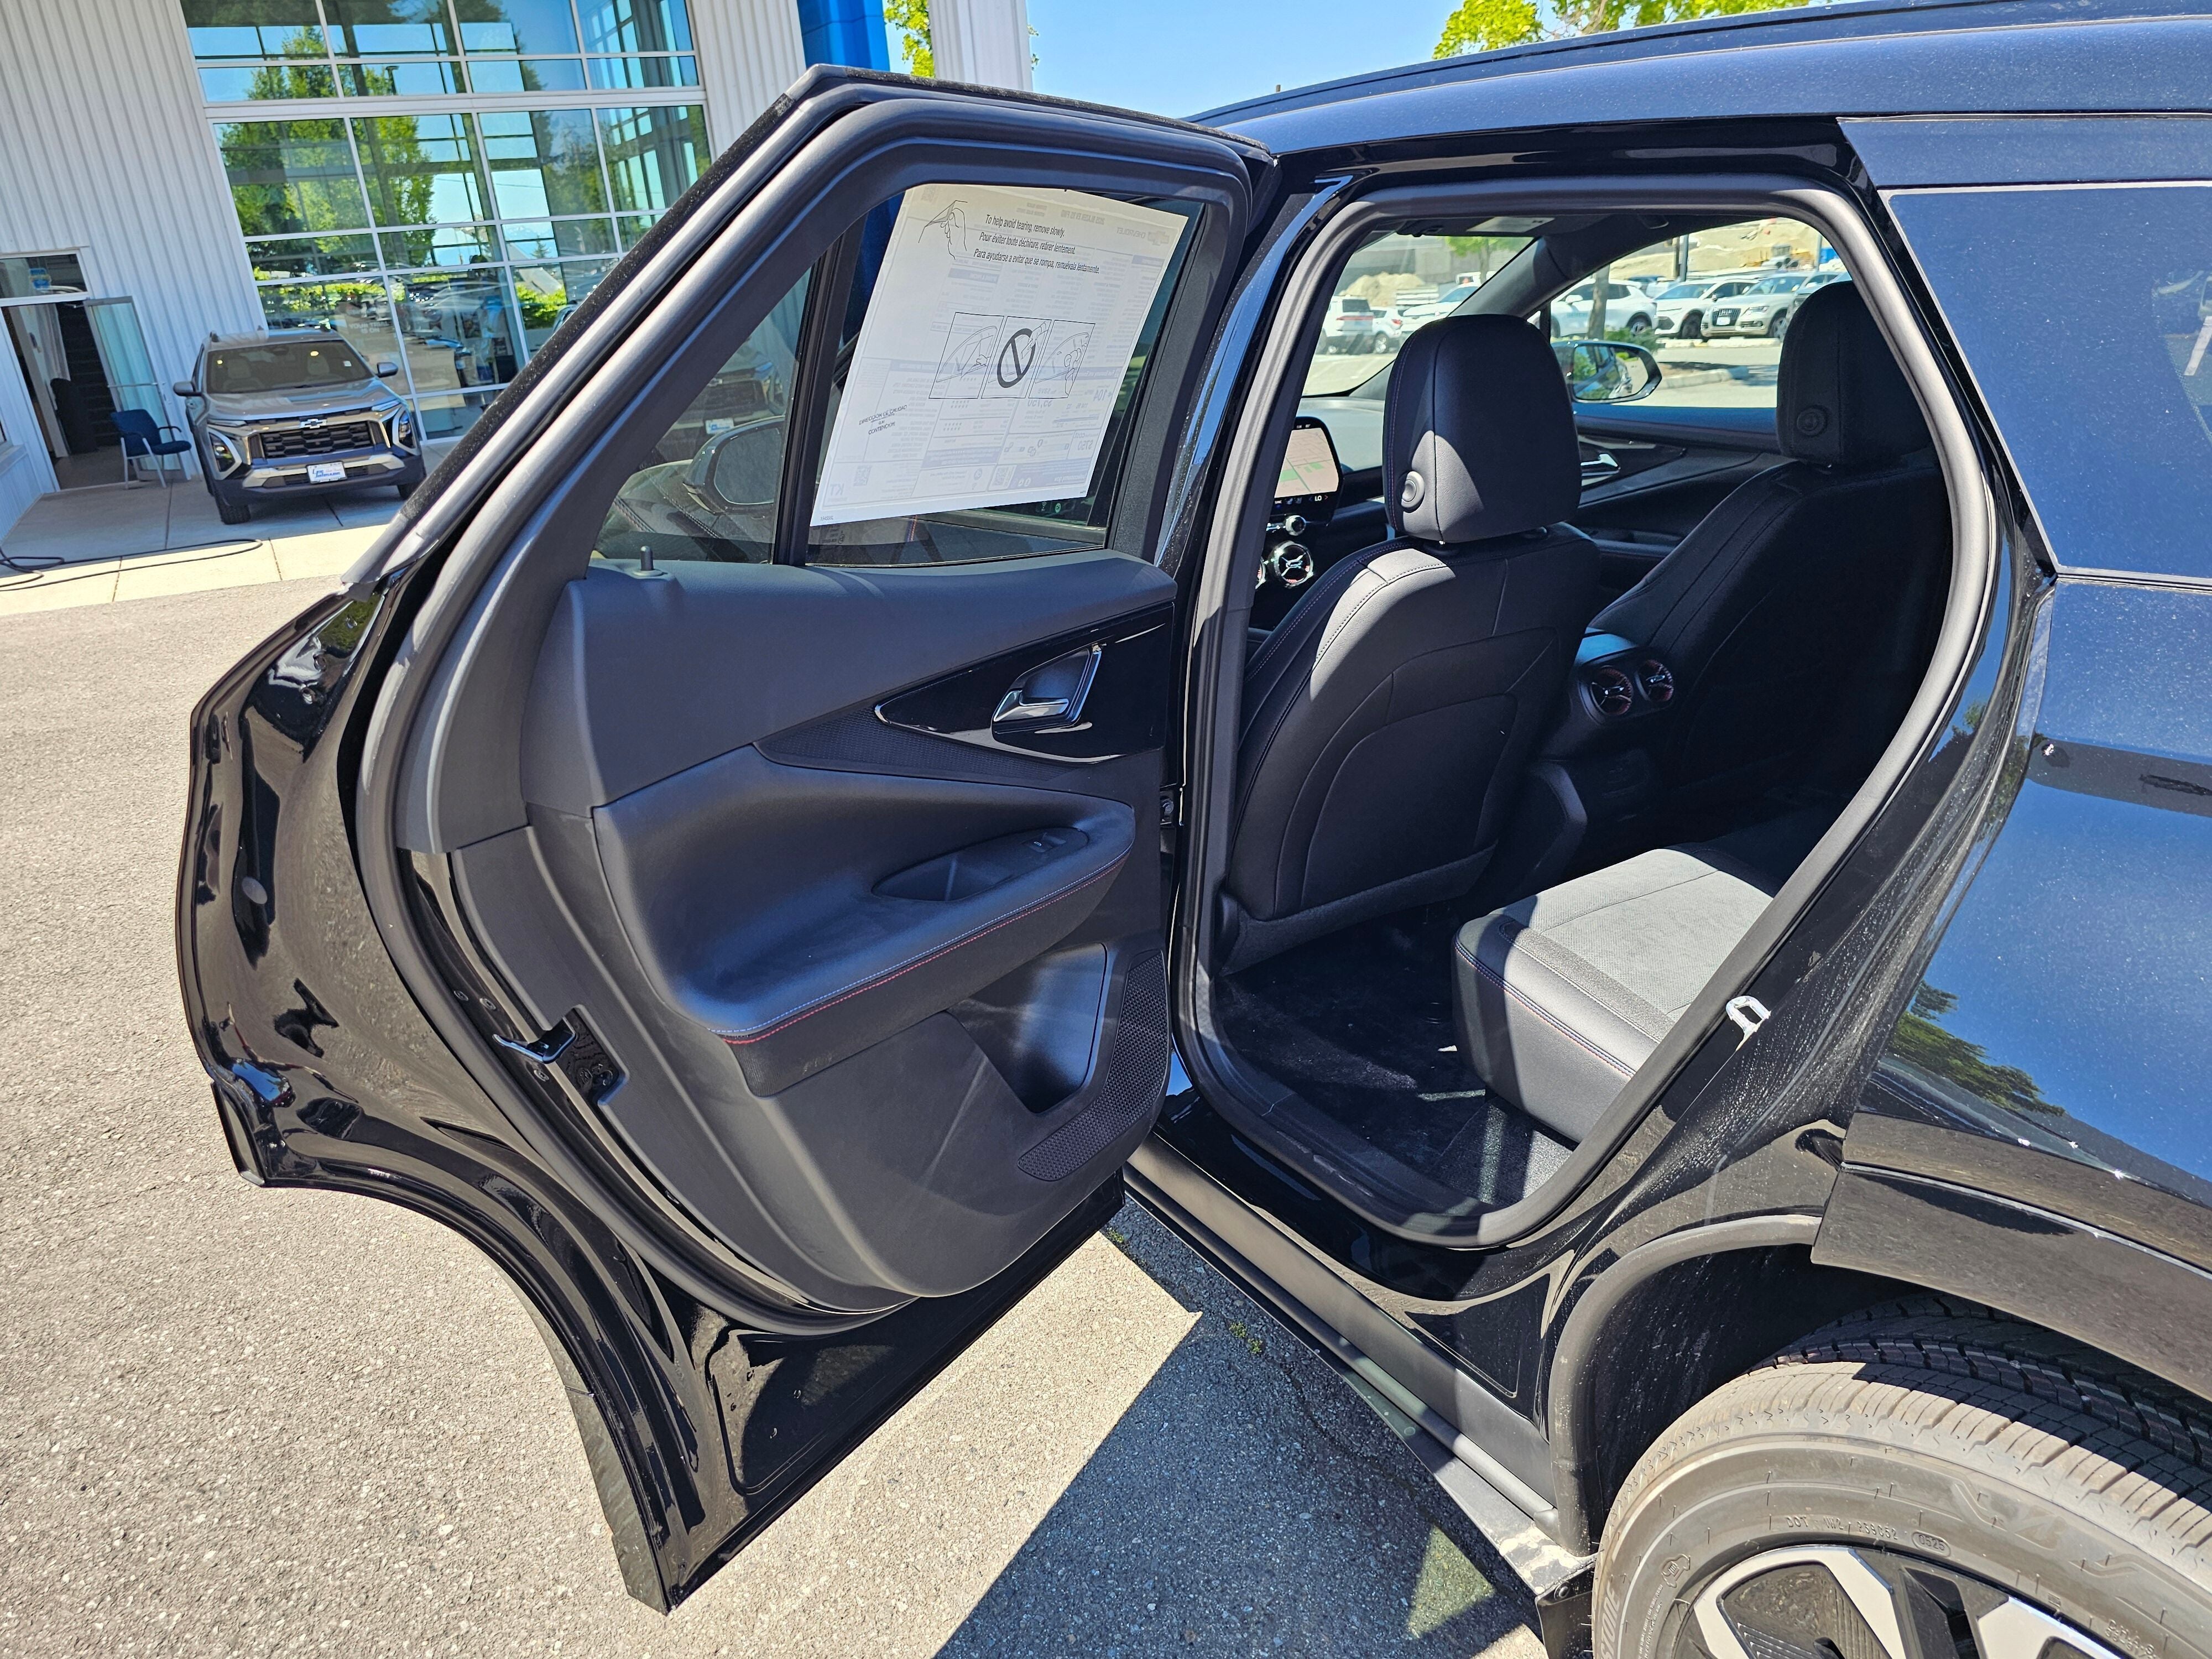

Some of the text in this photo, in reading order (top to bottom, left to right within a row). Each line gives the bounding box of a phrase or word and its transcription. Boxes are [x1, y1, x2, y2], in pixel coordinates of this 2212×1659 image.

[985, 214, 1065, 238] To help avoid tearing, remove slowly.
[979, 232, 992, 242] Pour
[992, 233, 1006, 244] éviter
[1006, 236, 1019, 247] toute
[1018, 238, 1039, 250] déchirure,
[1040, 242, 1054, 252] retirer
[973, 248, 985, 258] Para
[986, 251, 1009, 262] ayudarse
[1012, 254, 1025, 263] evitar
[1024, 257, 1034, 266] que
[1039, 258, 1055, 268] rompa,
[1785, 1515, 1809, 1528] DOT
